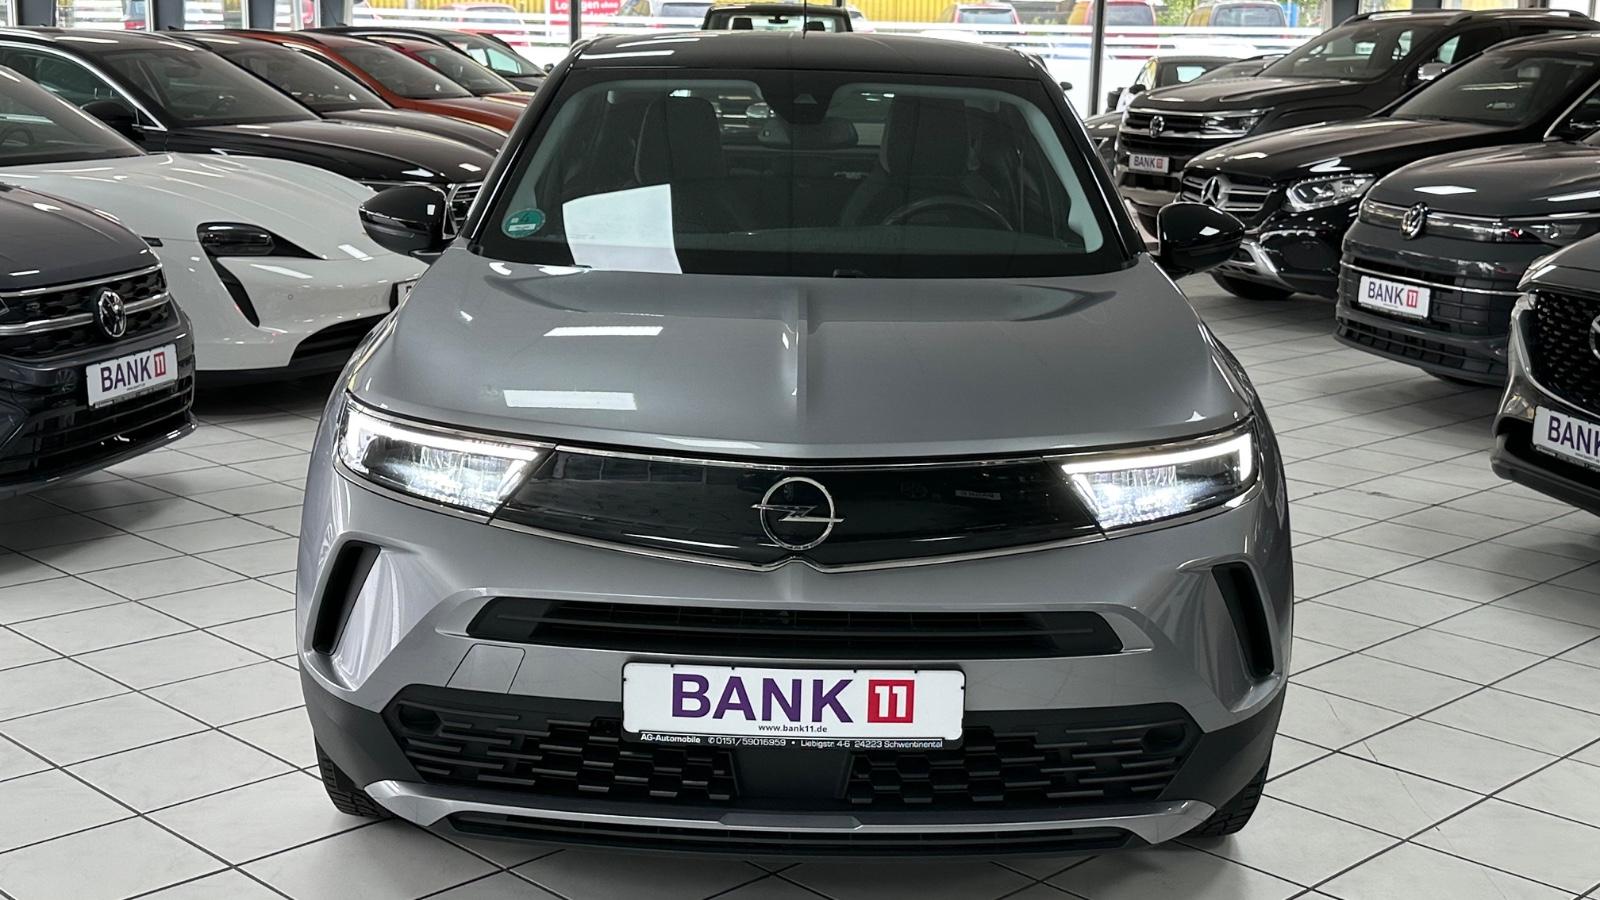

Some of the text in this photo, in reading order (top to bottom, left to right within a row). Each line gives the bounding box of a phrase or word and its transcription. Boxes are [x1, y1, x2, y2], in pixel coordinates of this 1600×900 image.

[1134, 155, 1156, 169] BANK
[1368, 281, 1404, 306] BANK
[100, 355, 152, 393] BANK
[671, 673, 853, 723] BANK
[758, 724, 828, 734] www.bank11.de
[640, 733, 701, 744] AG-Automobile
[854, 741, 883, 749] 24223
